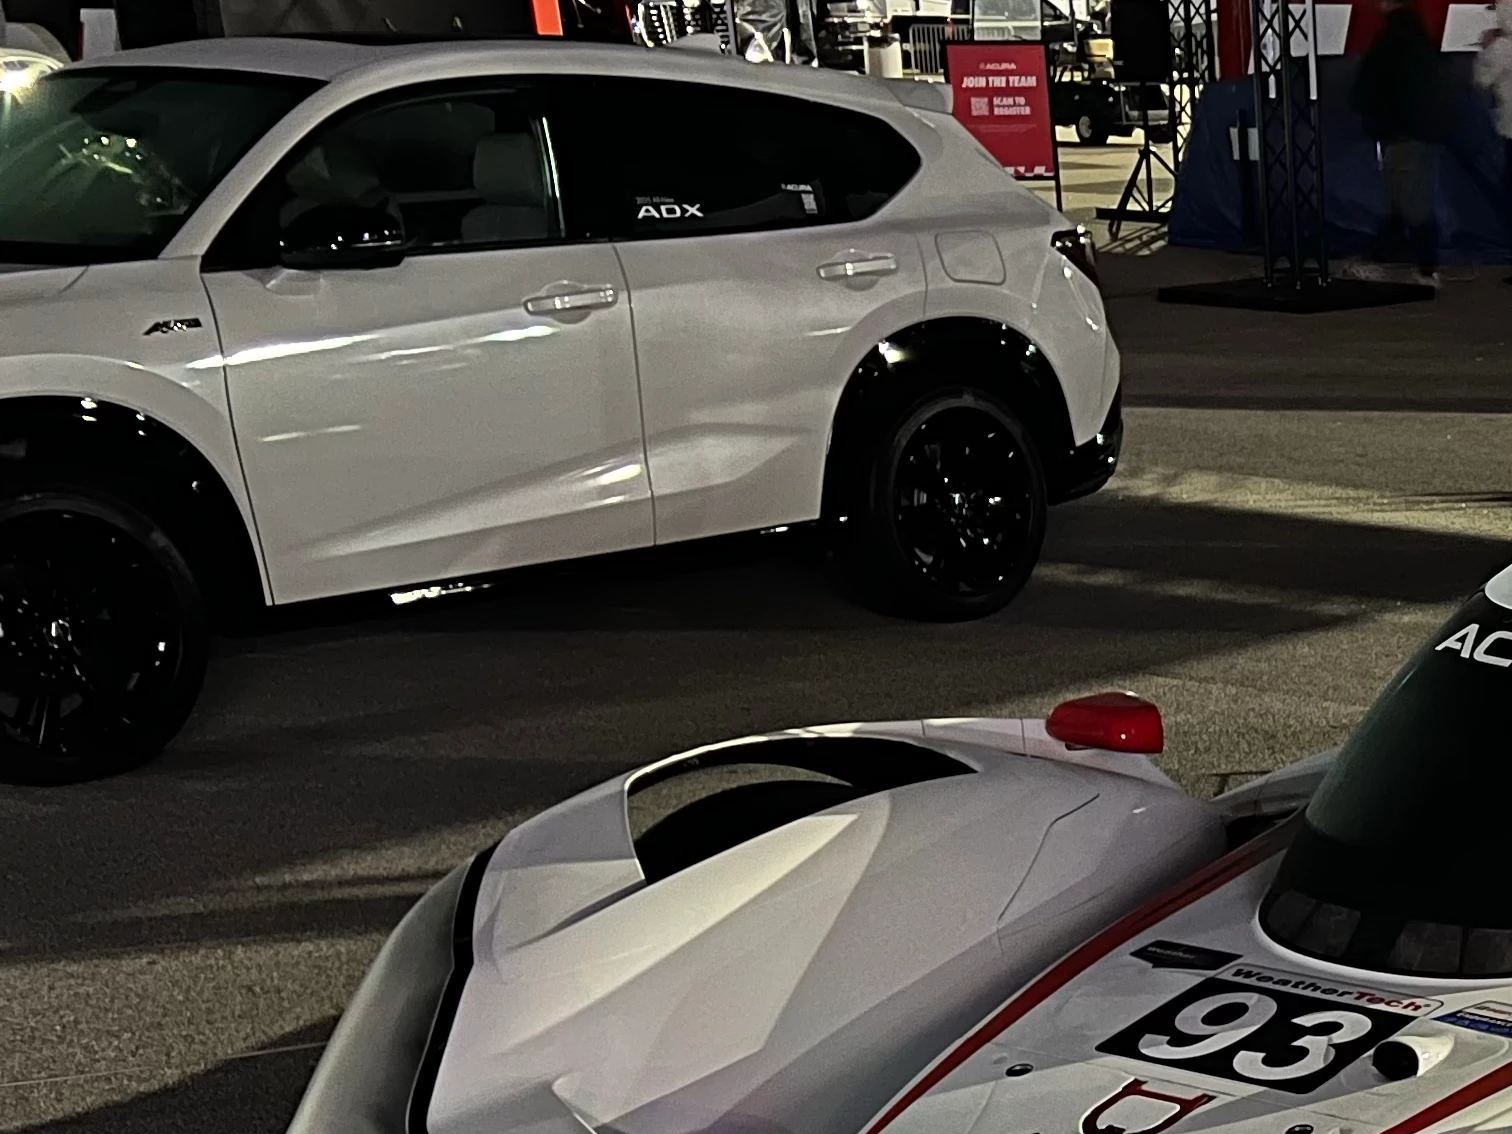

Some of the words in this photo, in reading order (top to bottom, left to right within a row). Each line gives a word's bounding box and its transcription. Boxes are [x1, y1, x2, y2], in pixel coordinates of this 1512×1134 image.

[962, 76, 987, 88] JOIN
[988, 76, 1007, 88] THE
[1008, 76, 1037, 88] TEAM
[1014, 96, 1026, 106] TO
[637, 203, 704, 220] ADX
[1231, 967, 1424, 1012] WeatherTech
[1138, 991, 1373, 1081] 93
